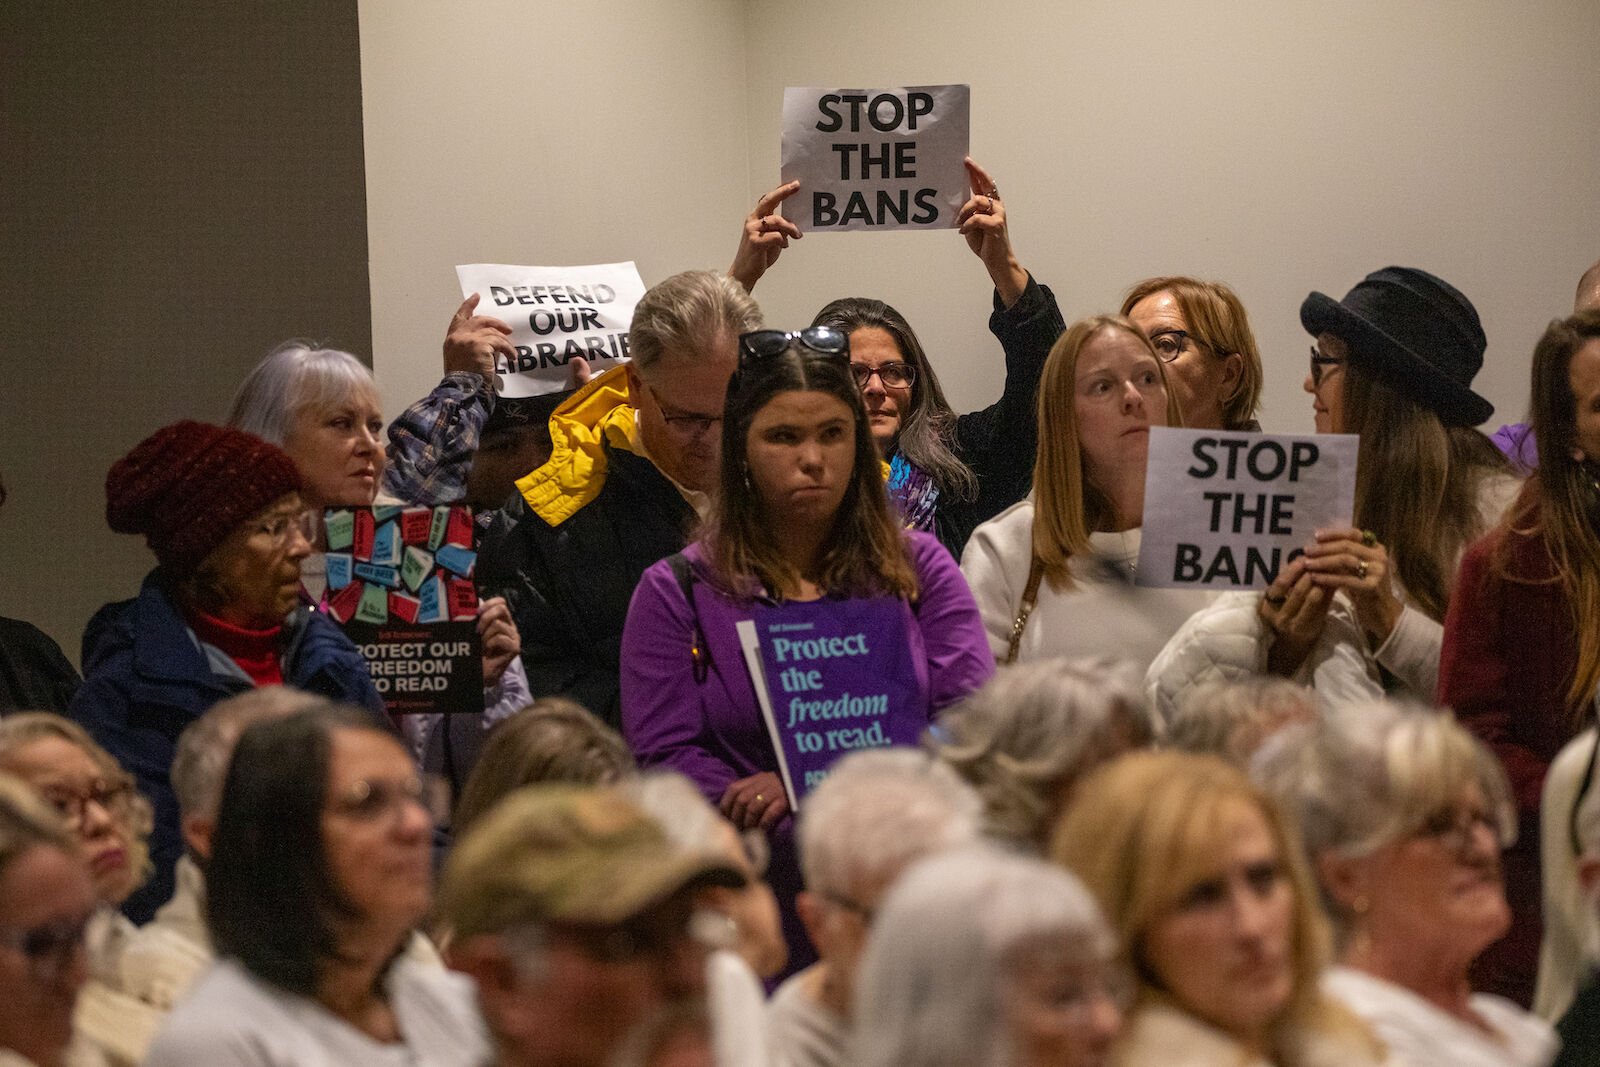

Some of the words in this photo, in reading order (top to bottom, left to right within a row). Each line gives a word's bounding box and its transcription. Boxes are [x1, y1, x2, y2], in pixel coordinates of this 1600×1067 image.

[815, 92, 934, 133] STOP
[832, 142, 917, 181] THE
[813, 188, 939, 227] BANS
[490, 283, 617, 307] DEFEND
[529, 307, 606, 336] OUR
[494, 332, 632, 375] LIBRARIE
[1187, 437, 1320, 482] STOP
[1203, 492, 1296, 535] THE
[1173, 543, 1305, 586] BAN
[354, 643, 427, 659] ROTECT
[429, 641, 471, 657] OUR
[772, 632, 871, 663] Protect
[364, 659, 453, 676] REEDOM
[370, 677, 391, 692] O
[395, 676, 449, 692] READ
[780, 666, 824, 692] the
[787, 692, 890, 729] freedom
[794, 730, 824, 754] to
[826, 720, 893, 751] read.
